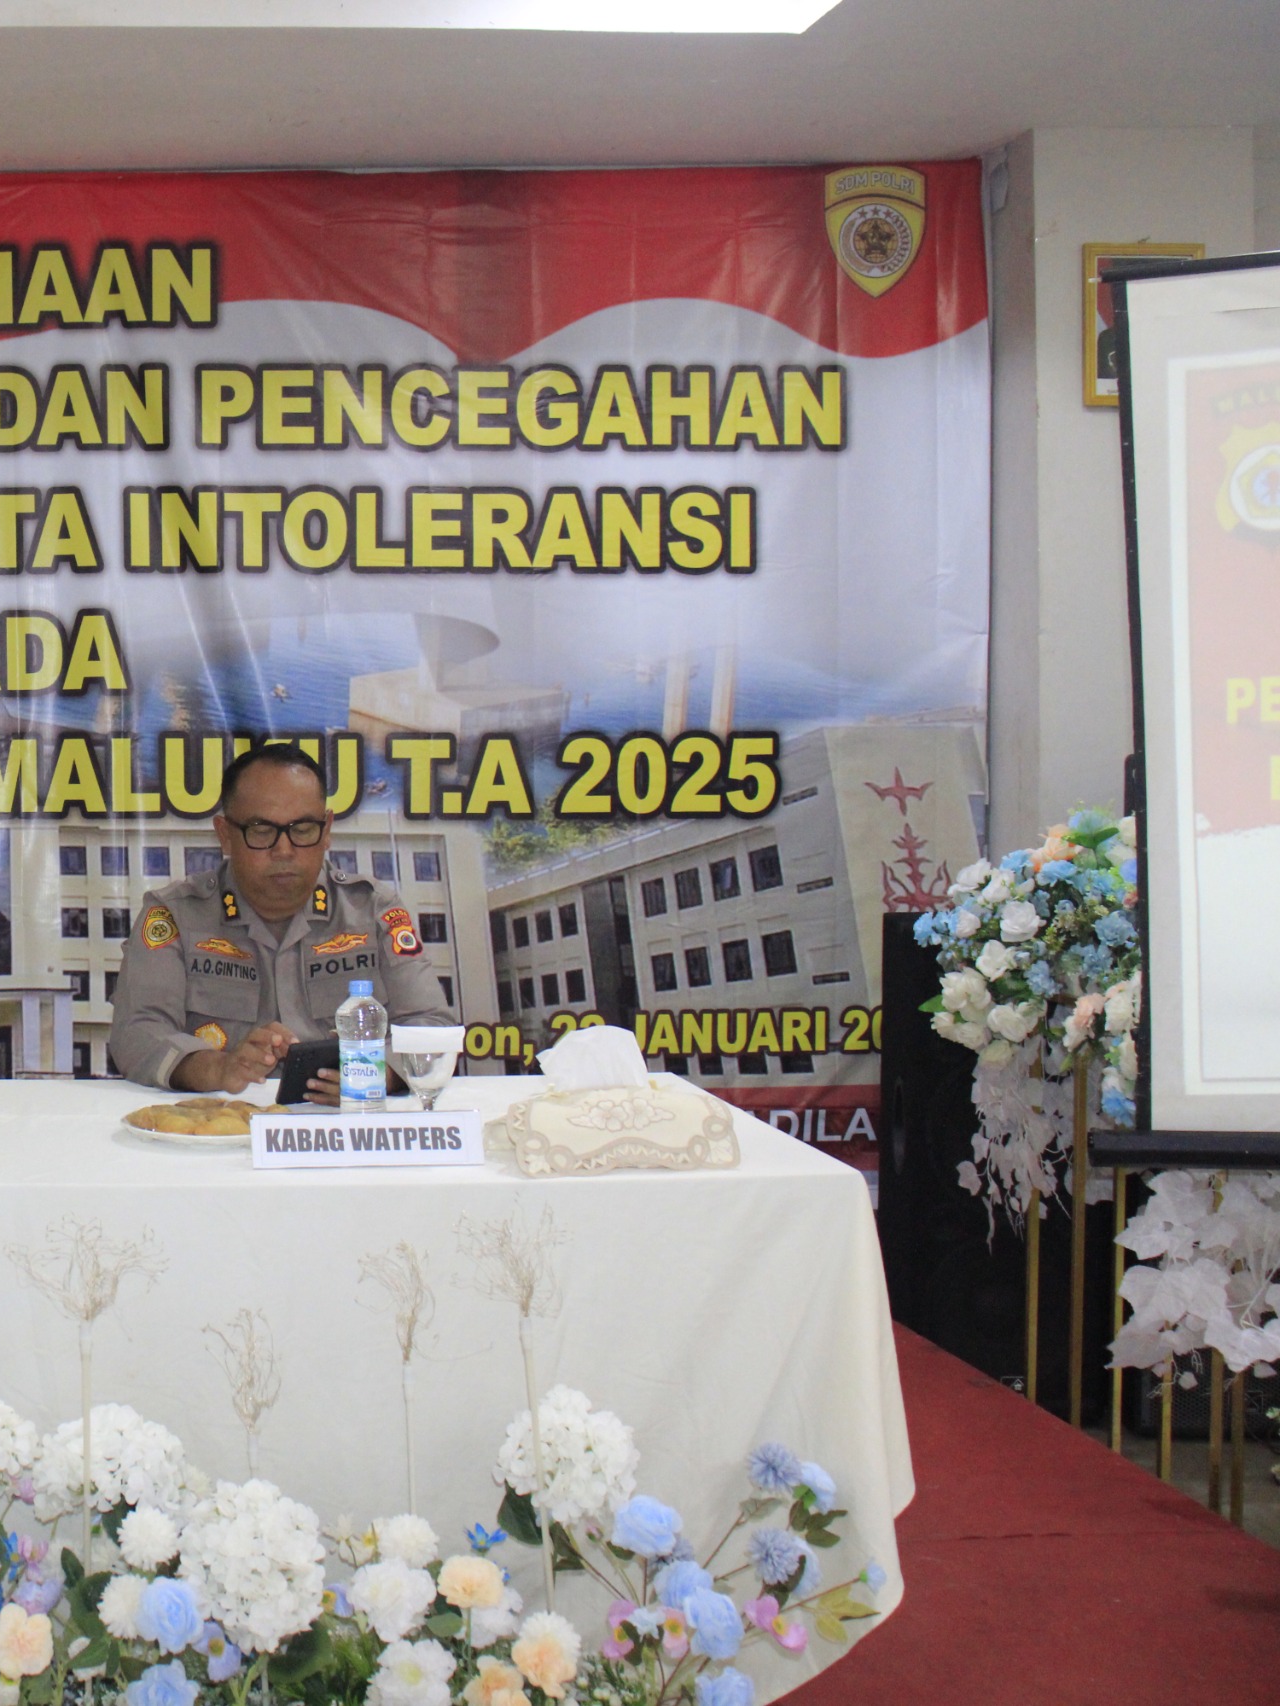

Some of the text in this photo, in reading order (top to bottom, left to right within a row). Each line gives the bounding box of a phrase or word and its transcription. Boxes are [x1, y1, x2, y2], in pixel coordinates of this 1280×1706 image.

[835, 171, 914, 195] SDM POLRI
[200, 368, 842, 447] PENCEGAHAN
[130, 492, 752, 569] INTOLERANSI
[391, 738, 533, 815] T.A
[560, 736, 776, 816] 2025
[309, 953, 376, 979] POLRI
[634, 1009, 827, 1056] JANUARI
[265, 1126, 462, 1153] KABAG WATPERS
